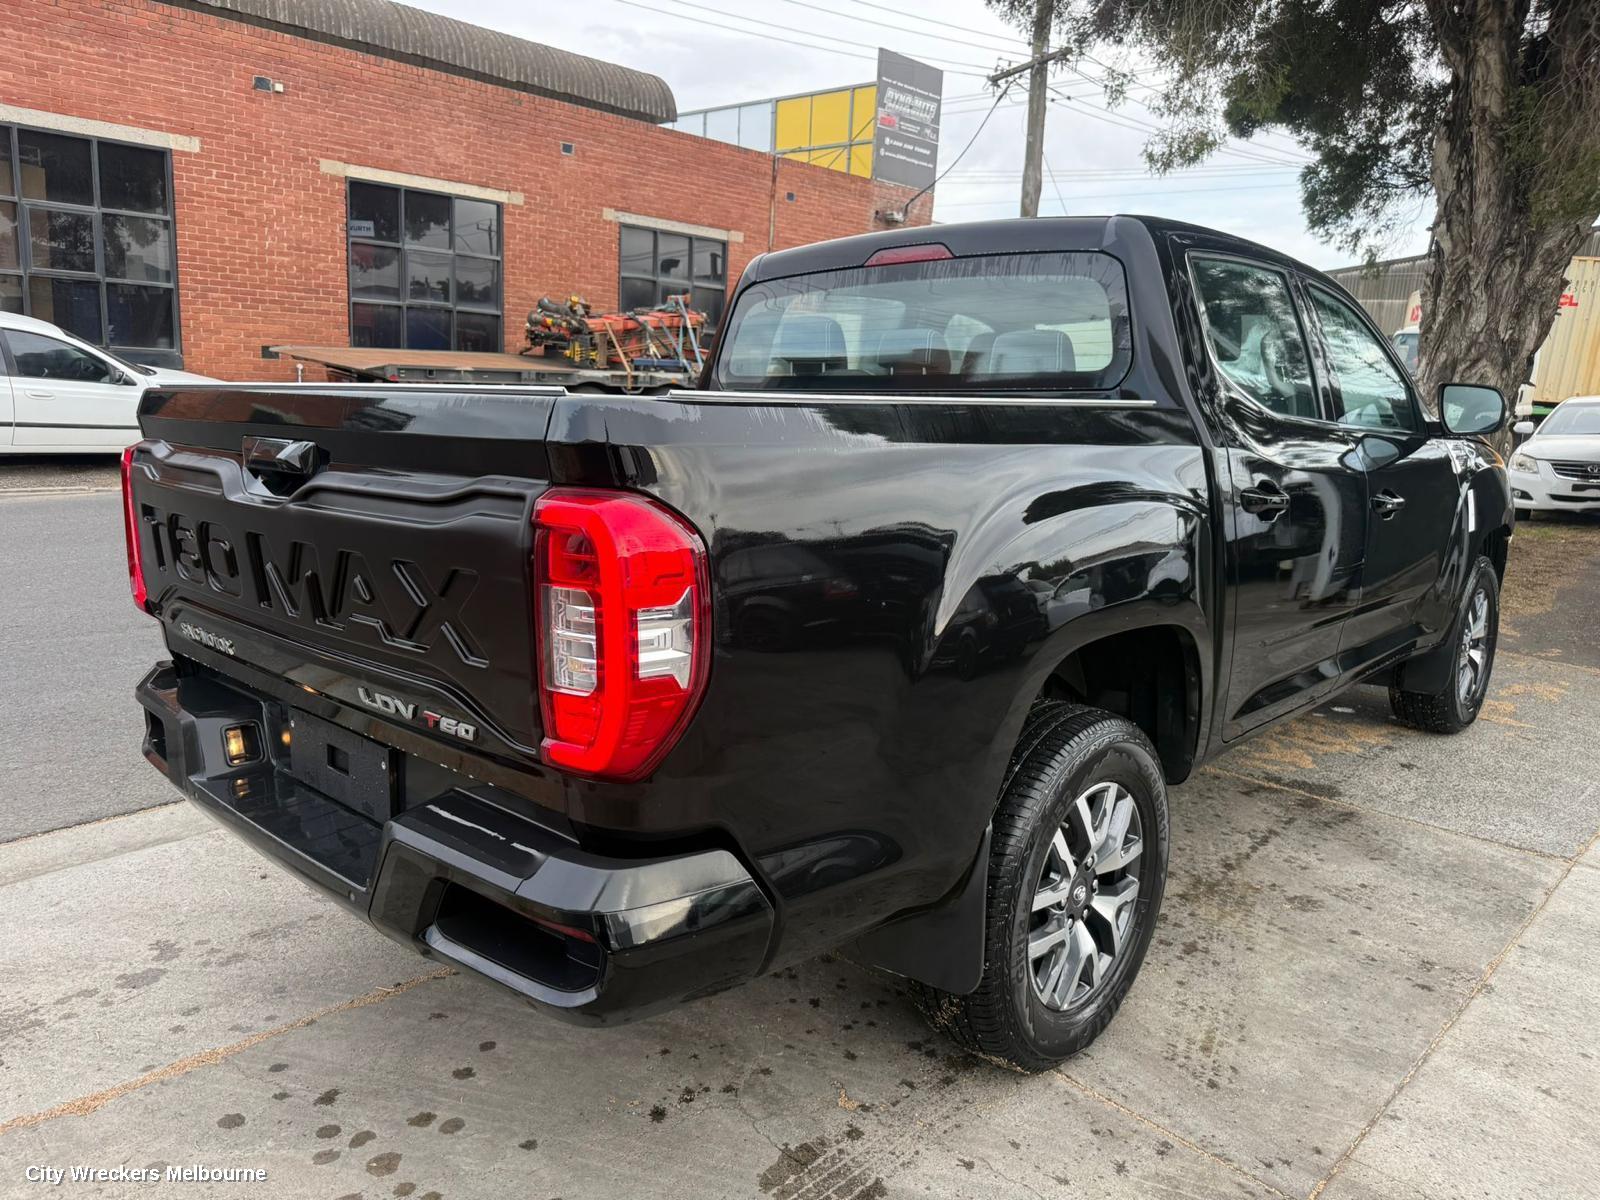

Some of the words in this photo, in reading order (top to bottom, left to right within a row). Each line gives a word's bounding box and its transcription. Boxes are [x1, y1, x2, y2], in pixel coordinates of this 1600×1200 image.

[245, 531, 490, 669] MAX
[357, 687, 417, 720] LDV
[423, 710, 477, 741] T60
